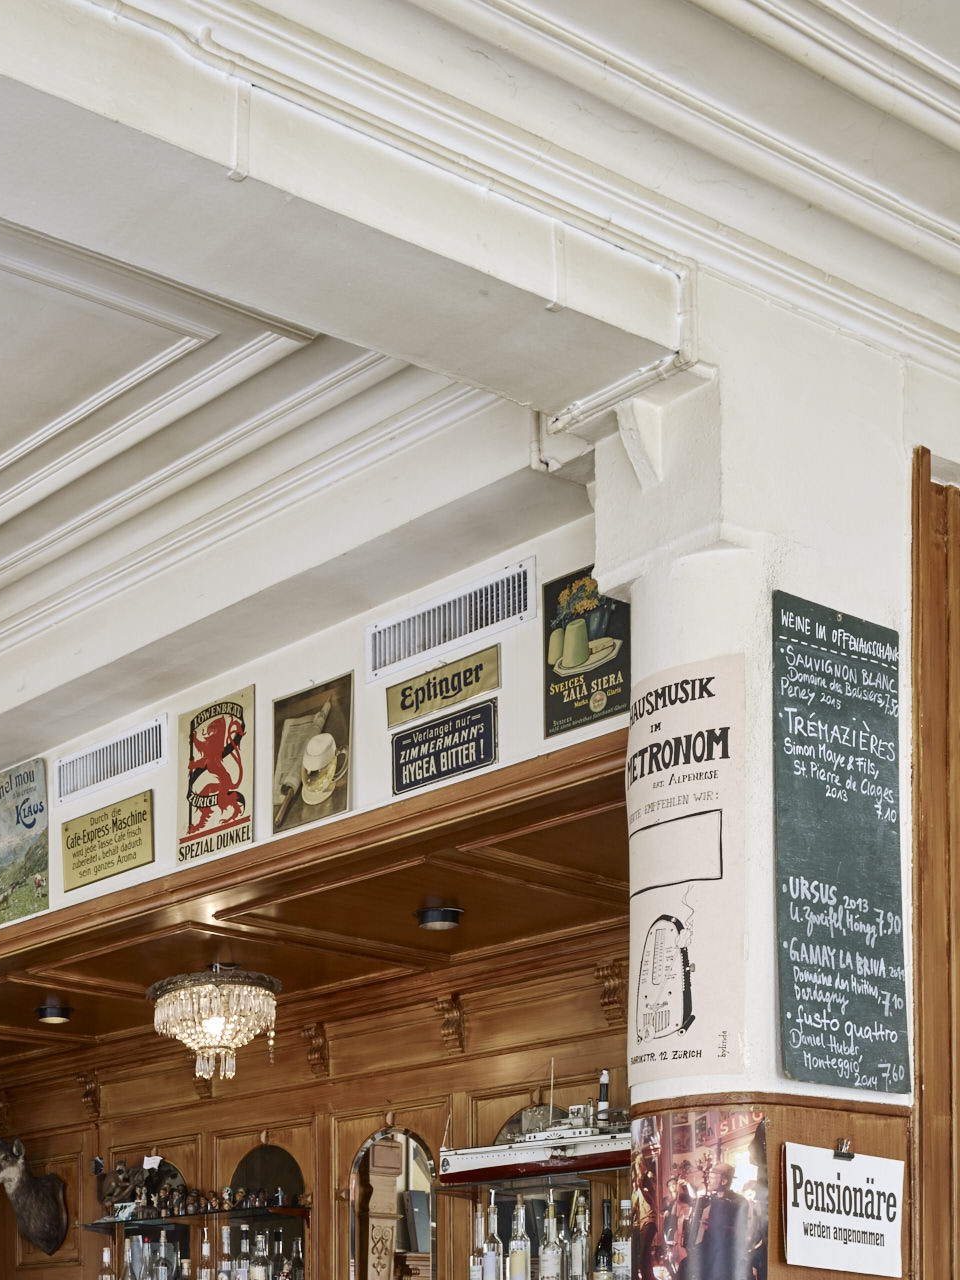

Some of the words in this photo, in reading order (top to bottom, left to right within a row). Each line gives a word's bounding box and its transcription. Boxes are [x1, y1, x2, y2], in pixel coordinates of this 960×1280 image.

[781, 608, 811, 635] WEINE
[815, 622, 827, 641] IM
[590, 670, 624, 693] SIERA
[785, 645, 858, 684] SAUVIGNON
[861, 668, 898, 694] BLANC
[787, 666, 827, 689] Domaine
[400, 663, 484, 713] Eptinger
[780, 676, 815, 706] Peney
[820, 692, 842, 710] 2015
[193, 703, 242, 727] LÖWENBRÄU
[412, 721, 453, 744] Verlanget
[455, 715, 472, 729] nur
[650, 721, 662, 733] IM
[784, 707, 896, 761] TRÉMAZIÈRES
[627, 726, 731, 790] METRONOM
[783, 737, 815, 759] Simon
[819, 743, 845, 771] Maye
[847, 755, 854, 771] &
[15, 770, 35, 787] mou
[402, 755, 437, 785] HYGEA
[668, 770, 720, 786] ALPENROSE
[793, 760, 808, 778] St.
[810, 761, 842, 787] Pierre
[845, 775, 857, 791] de
[861, 778, 895, 805] Clages
[189, 792, 218, 808] ZÜRICH
[644, 794, 689, 815] EMPFEHLEN
[825, 784, 848, 802] 2013
[15, 797, 45, 829] KLAUS
[90, 812, 108, 826] Durch
[111, 808, 122, 818] die
[874, 804, 897, 823] 7.10
[72, 848, 84, 859] wird
[84, 844, 97, 858] jede
[97, 837, 113, 849] Tasse
[126, 826, 142, 839] frisch
[120, 837, 143, 853] dadurch
[178, 838, 215, 862] SPEZIAL
[216, 824, 251, 851] DUNKEL
[79, 867, 92, 879] sein
[93, 860, 115, 876] ganzes
[116, 851, 137, 866] Aroma
[789, 876, 838, 905] URSUS
[842, 895, 869, 913] 2013
[873, 907, 901, 937] 7.90
[789, 937, 836, 970] GAMAY
[840, 949, 854, 970] LA
[855, 951, 886, 979] BRIVA
[793, 966, 832, 987] Domaine
[880, 990, 904, 1017] 7.10
[793, 983, 850, 1015] Dardagny
[795, 1004, 840, 1034] fusto
[844, 1021, 898, 1049] quattro
[658, 1052, 668, 1061] 12
[789, 1028, 826, 1048] Daniel
[827, 1034, 860, 1056] Huber
[854, 1072, 878, 1089] 2014
[877, 1063, 905, 1091] 7.60
[790, 1163, 897, 1223] Pensionäre
[803, 1221, 831, 1240] werden
[833, 1226, 885, 1247] angenommen
